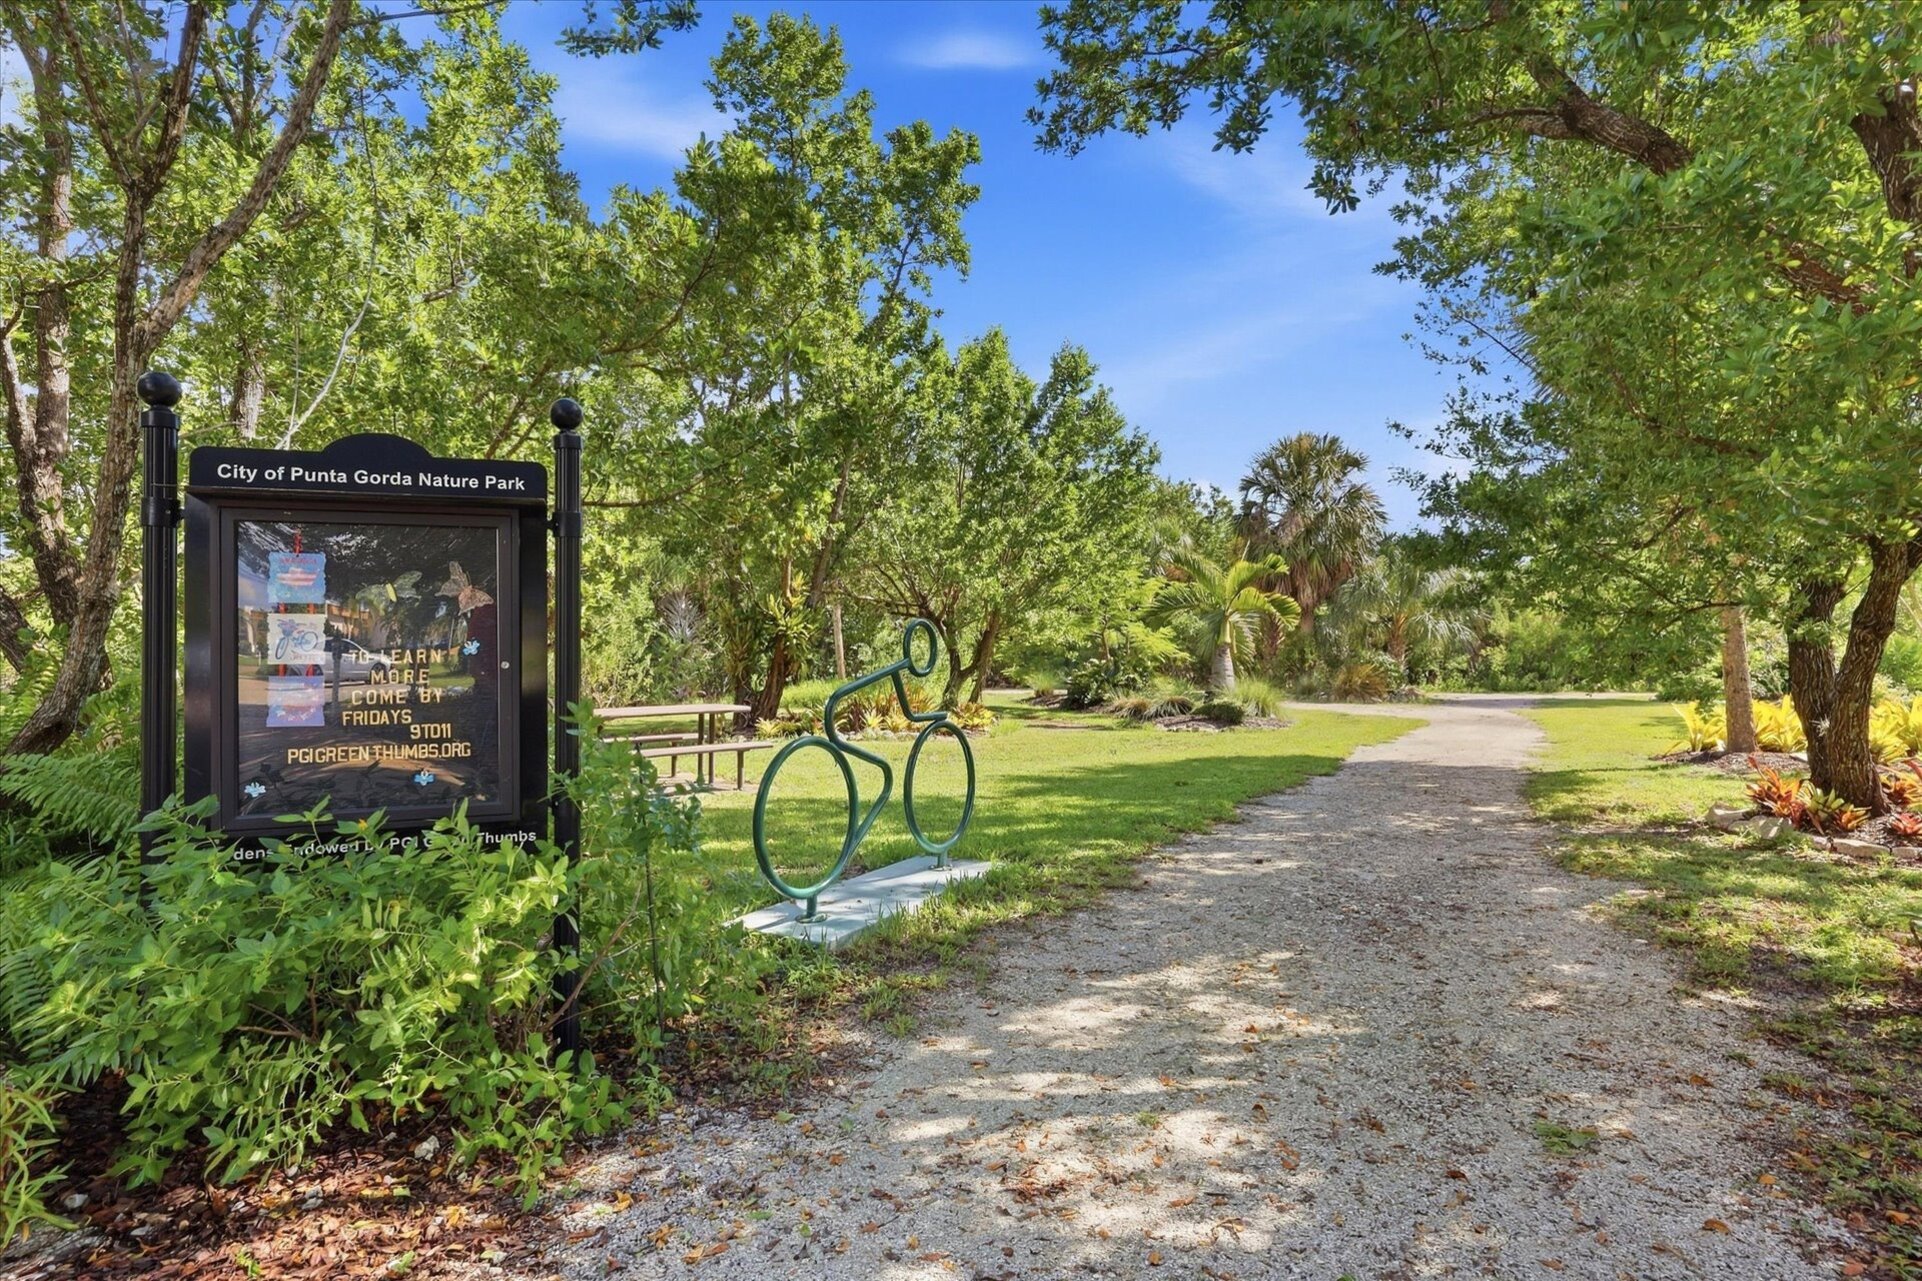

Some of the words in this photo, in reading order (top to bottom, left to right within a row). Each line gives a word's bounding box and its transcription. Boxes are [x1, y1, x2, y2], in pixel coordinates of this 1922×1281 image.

[216, 463, 258, 483] City
[264, 466, 286, 480] of
[290, 467, 348, 484] Punta
[353, 469, 413, 486] Gorda
[418, 472, 479, 488] Nature
[485, 475, 526, 491] Park
[349, 649, 370, 665] TO
[380, 648, 442, 664] LEARN
[370, 668, 430, 685] MORE
[351, 688, 409, 706] COME
[420, 687, 442, 703] BY
[342, 709, 412, 727] FRIDAYS
[285, 840, 359, 856] ndowed
